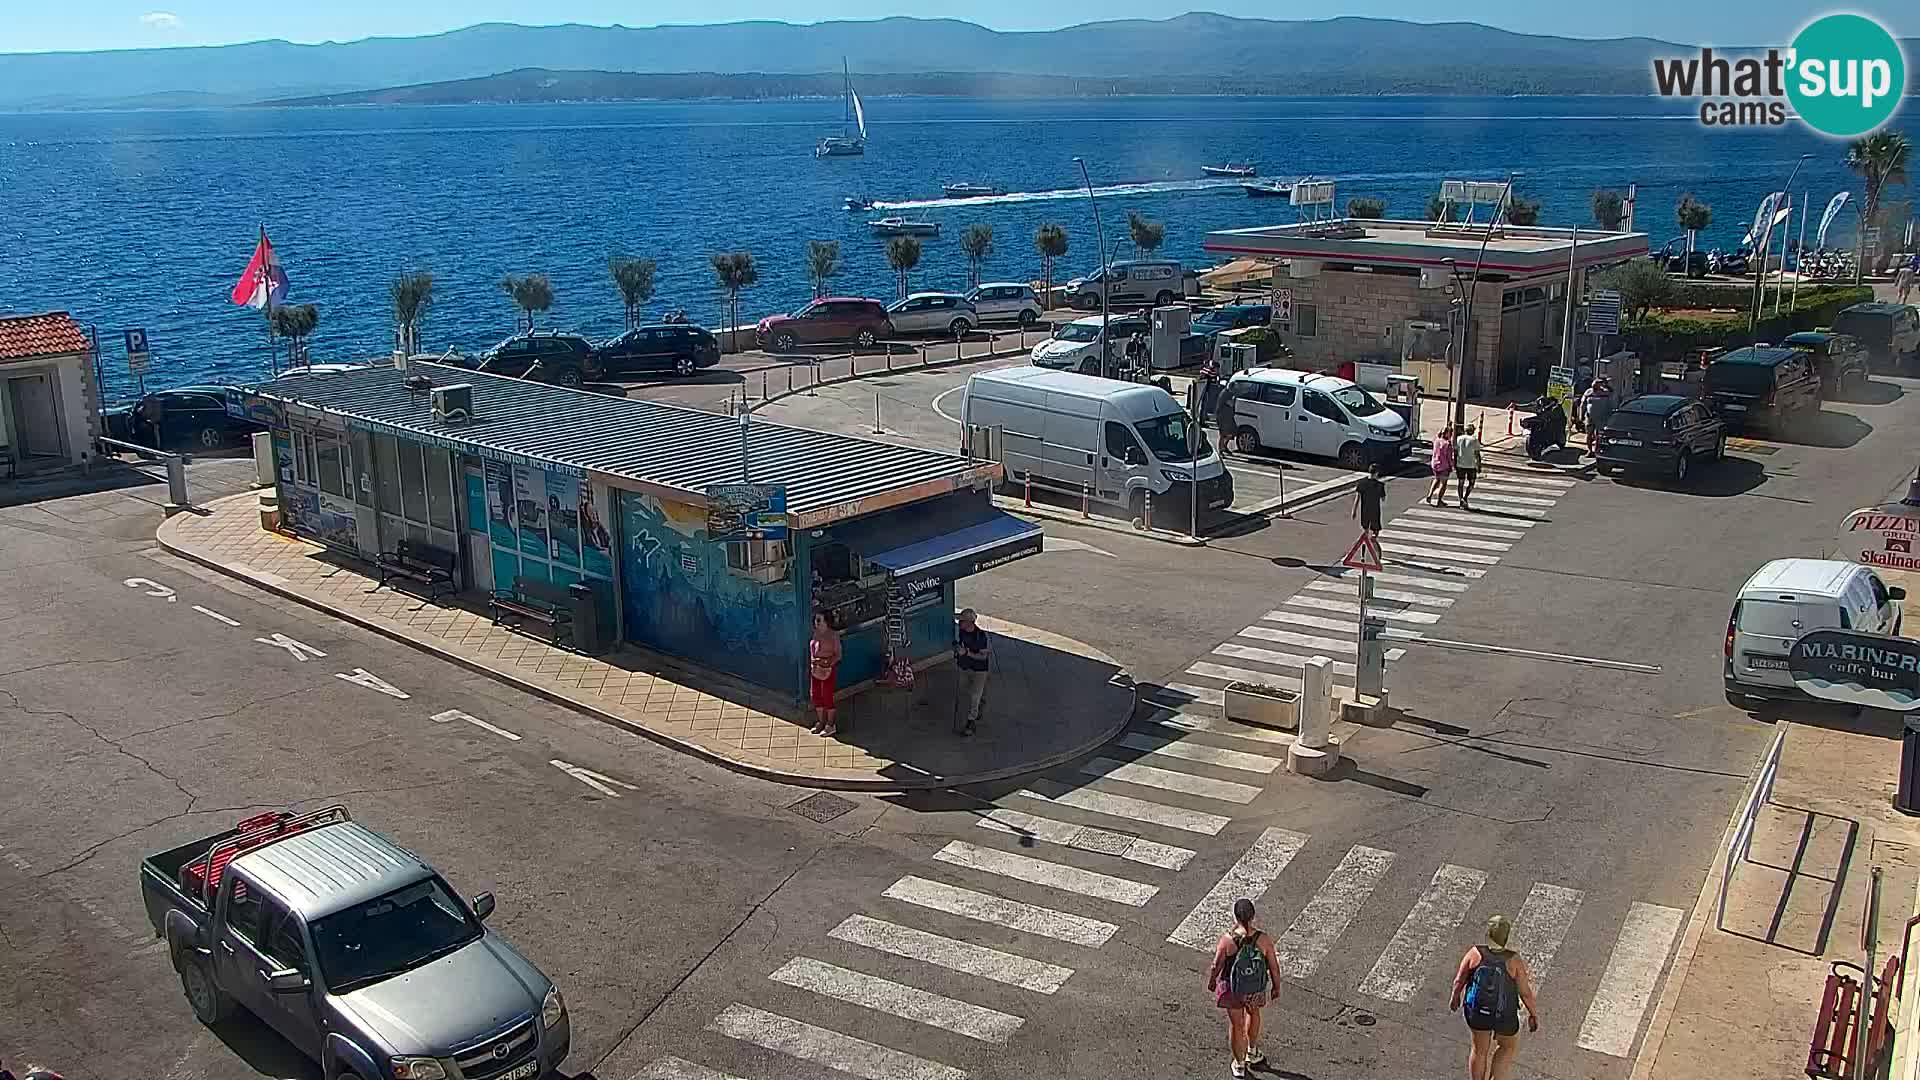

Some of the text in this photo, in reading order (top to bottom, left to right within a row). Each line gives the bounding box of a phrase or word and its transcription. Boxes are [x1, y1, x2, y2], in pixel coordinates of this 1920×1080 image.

[129, 332, 142, 350] P
[494, 451, 526, 465] STATION
[528, 458, 553, 471] TICKET
[555, 464, 582, 477] OFFICE
[1849, 516, 1920, 532] PIZZE
[1829, 663, 1897, 681] caffe bar
